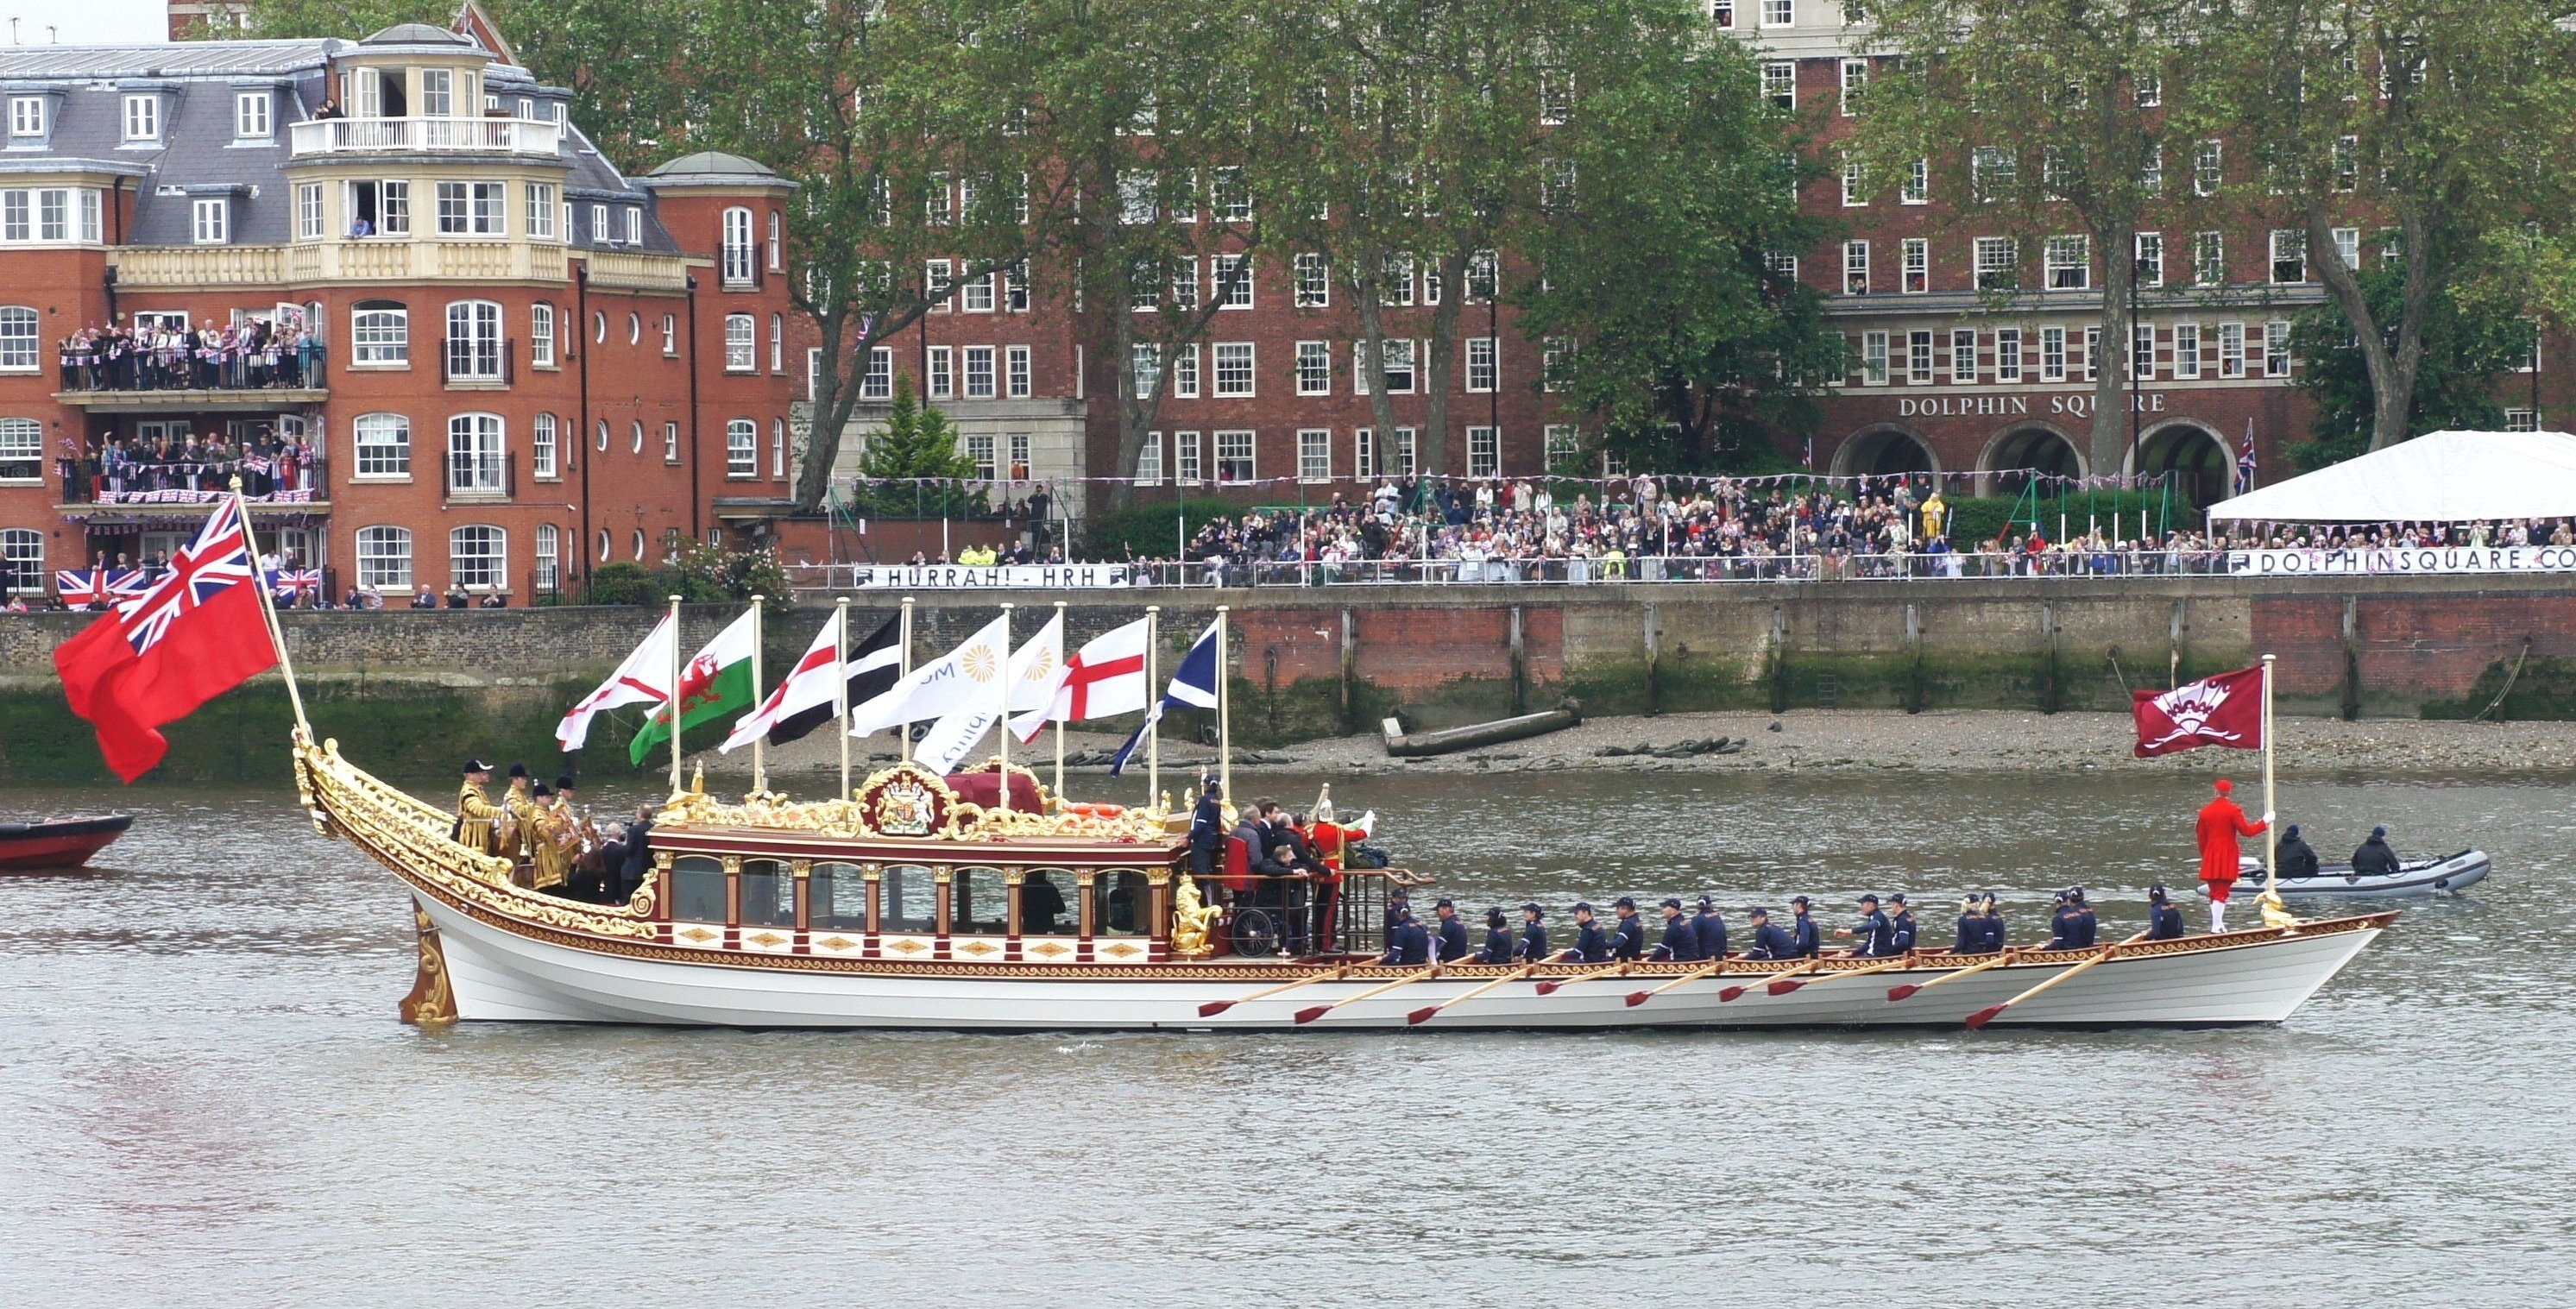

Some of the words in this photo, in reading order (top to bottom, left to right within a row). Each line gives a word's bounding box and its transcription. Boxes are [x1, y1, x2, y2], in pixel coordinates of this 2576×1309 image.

[1899, 396, 2028, 417] DOLPHIN
[2050, 393, 2165, 419] SQRE
[889, 568, 1010, 587] HURRAH!
[1042, 567, 1094, 587] HRH
